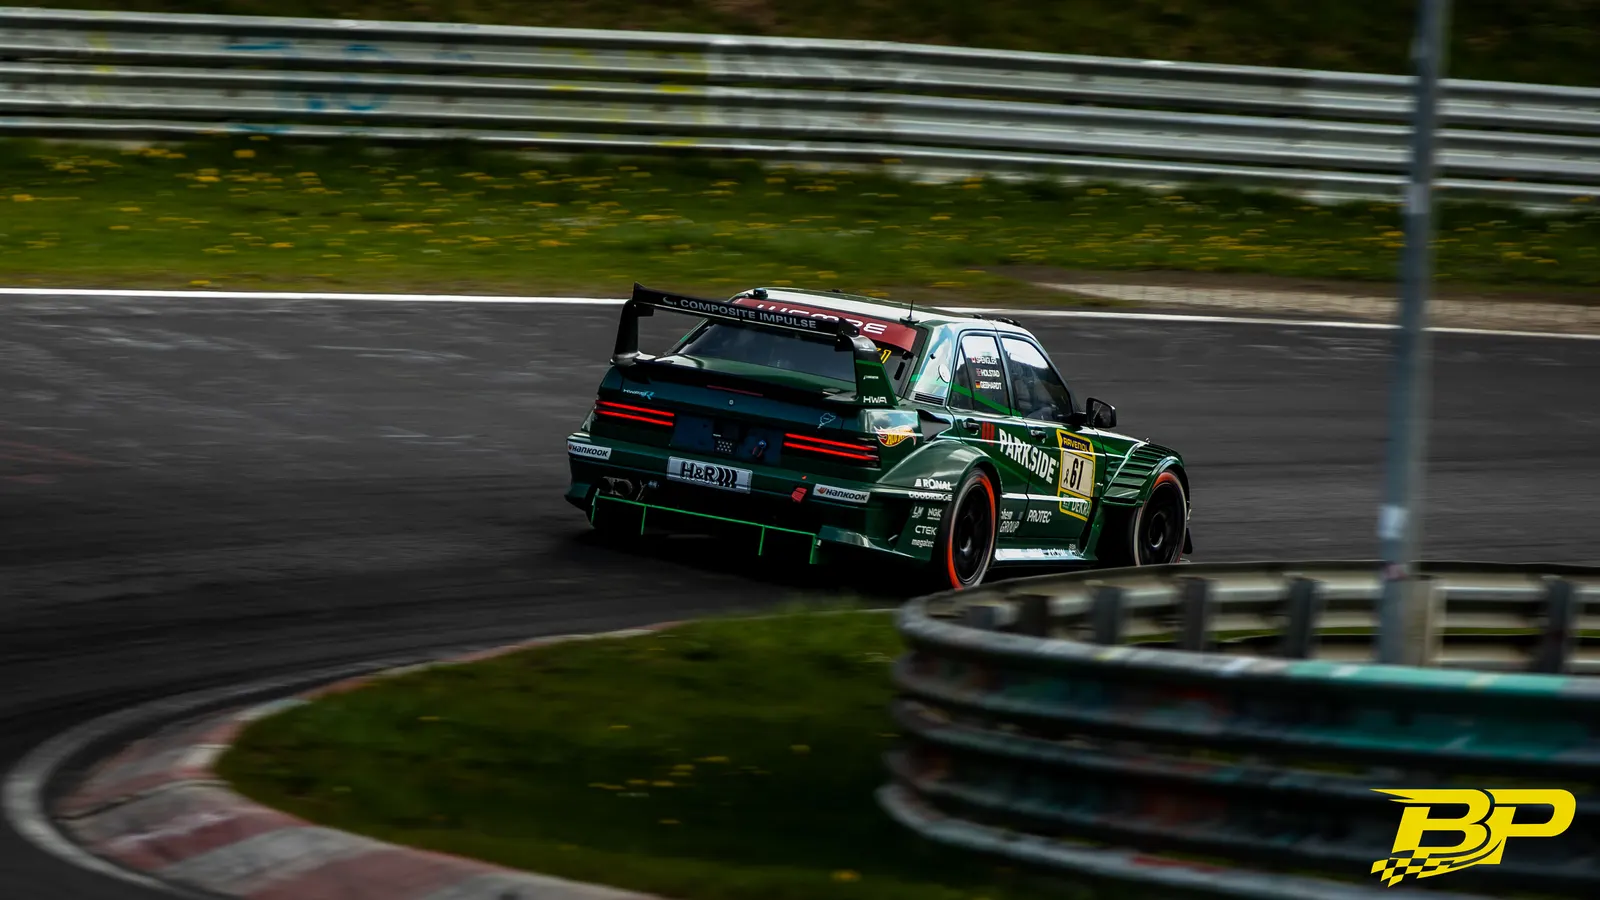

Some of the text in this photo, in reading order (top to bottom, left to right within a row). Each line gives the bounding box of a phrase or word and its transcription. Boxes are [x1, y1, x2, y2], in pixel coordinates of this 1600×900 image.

[681, 299, 817, 329] COMPOSITE IMPULSE
[981, 369, 1000, 377] HOLSTAD
[863, 395, 887, 404] HWA
[1062, 437, 1089, 453] RAVENOL
[999, 427, 1057, 484] PARKSIDE
[1069, 457, 1084, 491] 61
[922, 478, 953, 491] RONAL
[927, 507, 942, 518] NGK
[1026, 509, 1052, 523] PROTEC
[915, 525, 938, 536] CTEK
